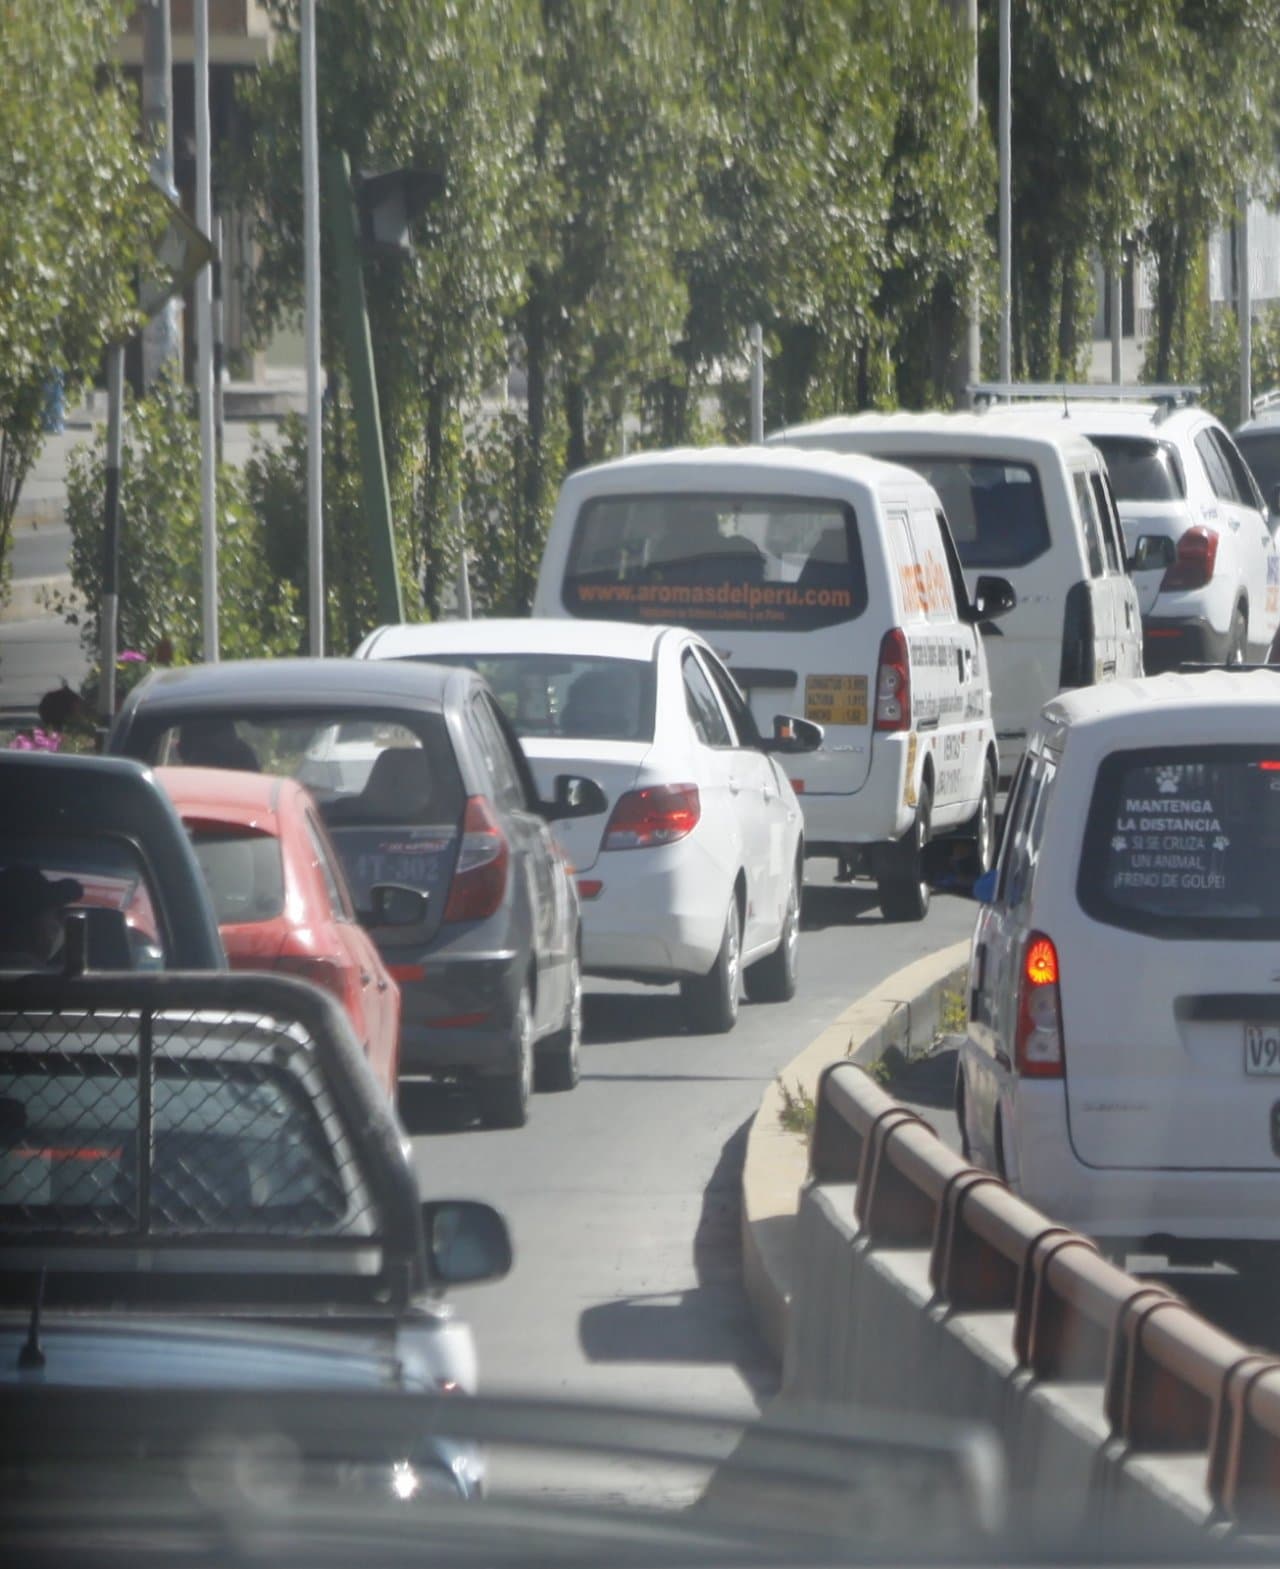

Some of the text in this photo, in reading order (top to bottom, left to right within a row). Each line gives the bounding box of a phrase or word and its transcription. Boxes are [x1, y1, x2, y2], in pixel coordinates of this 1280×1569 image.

[578, 581, 851, 608] www.aromasdelperu.com
[1126, 799, 1213, 813] MANTENGA
[1117, 818, 1221, 832] LA DISTANCIA
[1163, 836, 1205, 851] CRUZA
[1131, 855, 1151, 868] UN
[1162, 873, 1179, 888] DE
